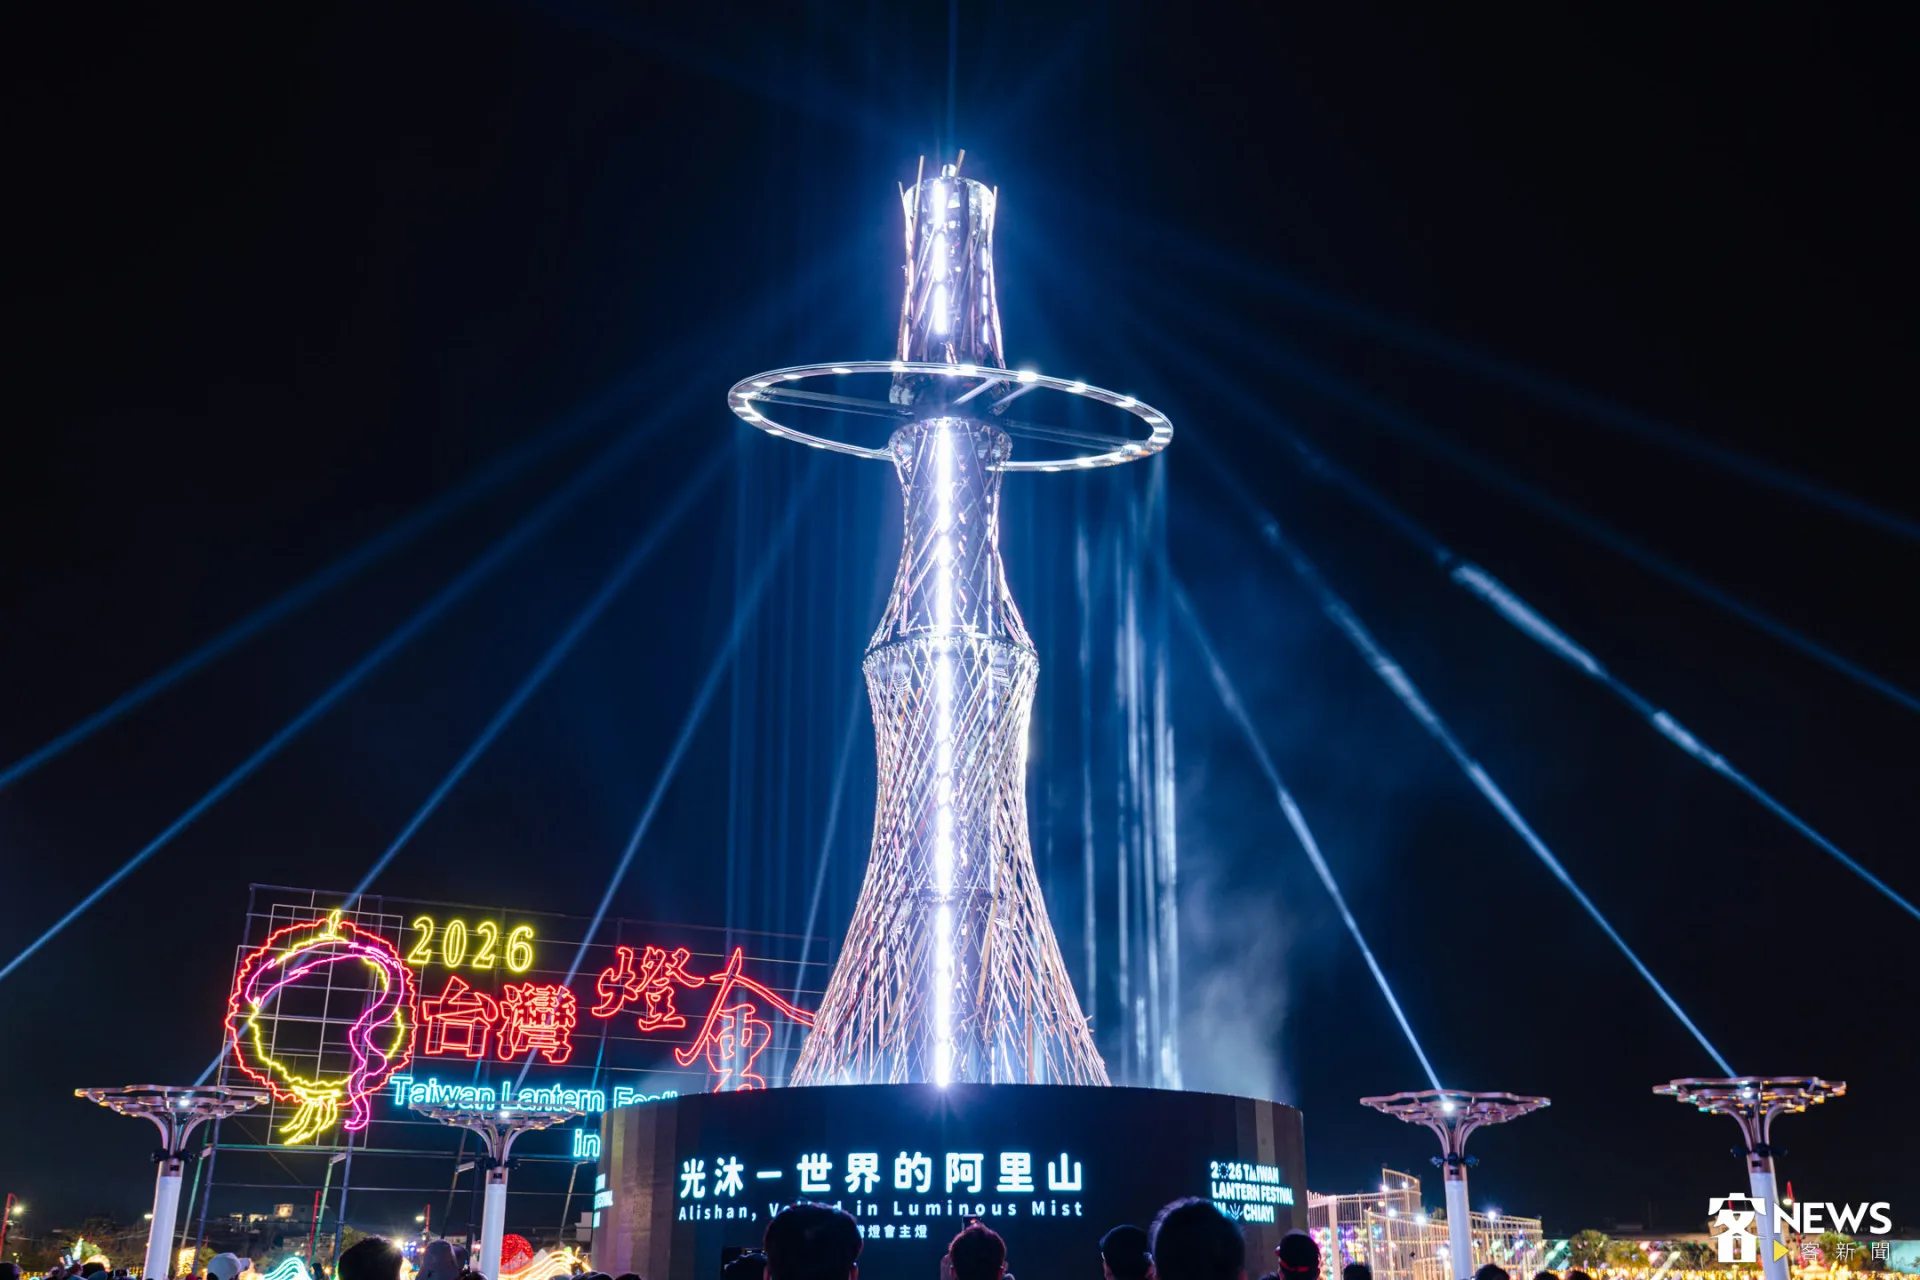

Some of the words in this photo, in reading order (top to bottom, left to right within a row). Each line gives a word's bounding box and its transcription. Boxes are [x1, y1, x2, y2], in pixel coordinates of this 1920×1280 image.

[407, 916, 534, 972] 2026
[389, 1075, 495, 1110] Taiwan
[501, 1081, 605, 1112] Lantern
[573, 1128, 600, 1157] in
[1210, 1161, 1242, 1180] 2026
[1243, 1164, 1279, 1184] TAIWAN
[1211, 1181, 1260, 1202] LANTERN
[1260, 1184, 1294, 1205] FESTIVAL
[679, 1204, 757, 1221] Alishan,
[857, 1200, 878, 1216] in
[893, 1200, 1017, 1216] Luminous
[1032, 1200, 1082, 1216] Mist
[1243, 1203, 1274, 1223] CHIAYI
